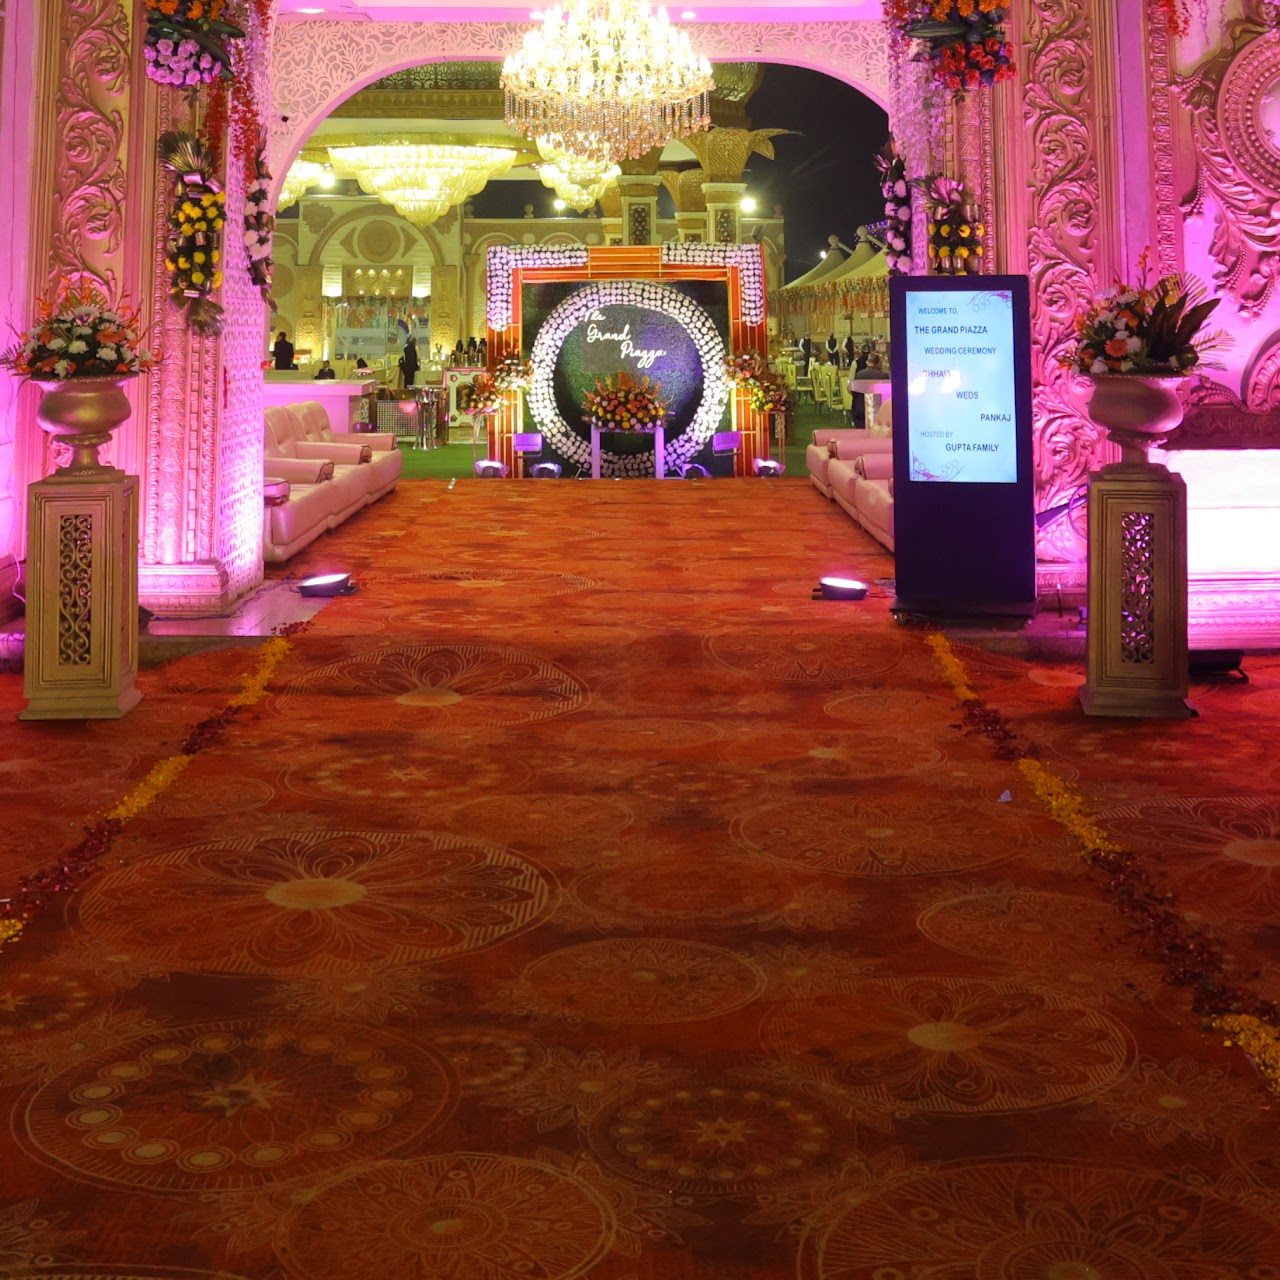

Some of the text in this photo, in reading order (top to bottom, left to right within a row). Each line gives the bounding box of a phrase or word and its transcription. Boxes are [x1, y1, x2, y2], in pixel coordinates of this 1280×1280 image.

[918, 307, 959, 315] WELCOME TO,
[584, 310, 606, 322] The
[586, 324, 632, 343] Grand
[914, 326, 988, 334] THE GRAND PIAZZA
[620, 340, 667, 368] Piazza
[924, 347, 997, 355] WEDDING CEREMONY
[956, 391, 979, 400] WEDS
[980, 414, 1012, 422] PANKAJ
[945, 443, 999, 452] GUPTA FAMILY
